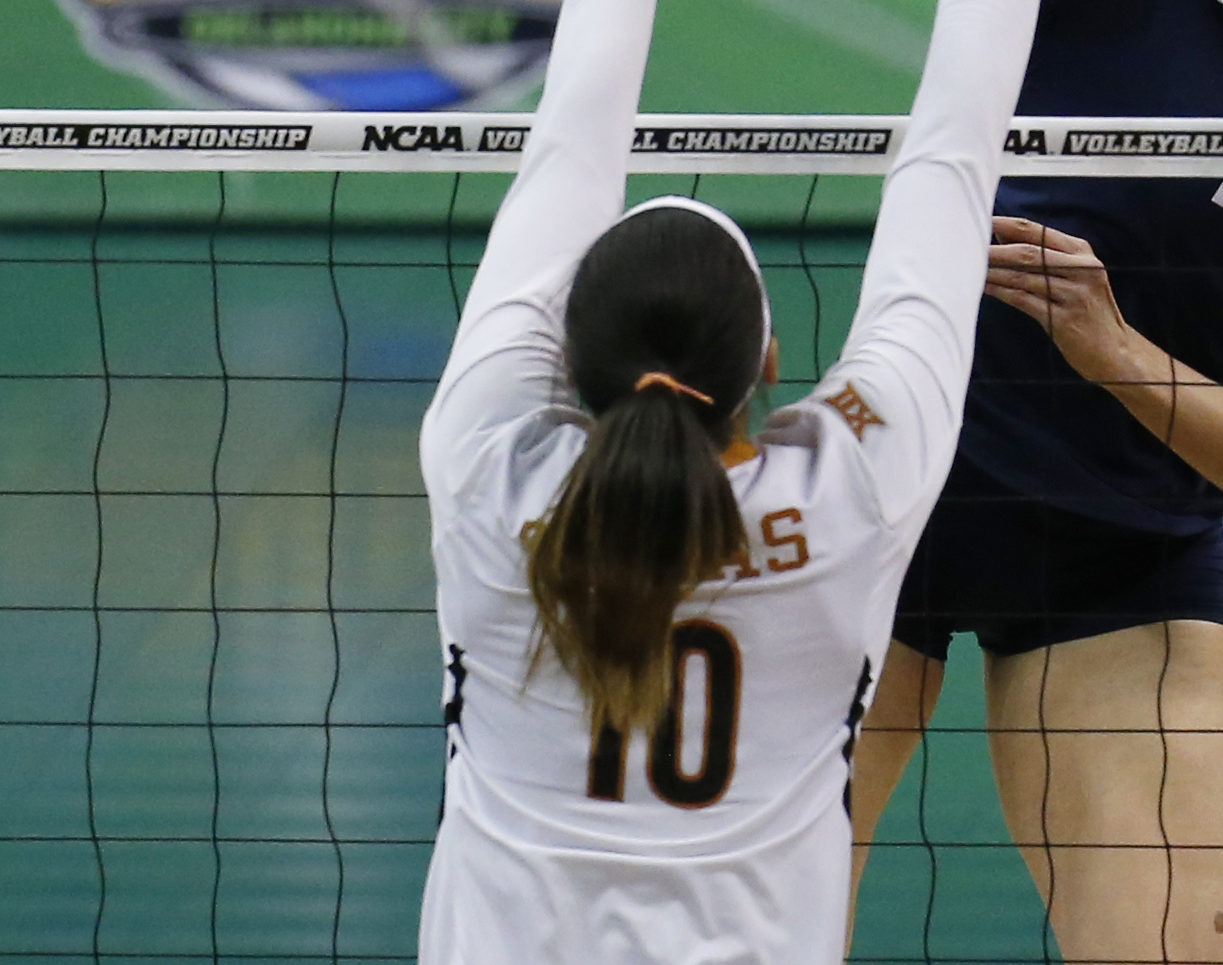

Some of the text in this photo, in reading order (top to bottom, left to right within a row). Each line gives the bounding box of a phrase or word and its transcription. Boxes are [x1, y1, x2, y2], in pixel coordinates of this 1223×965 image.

[87, 127, 306, 148] CHAMPIONSHIP
[362, 125, 464, 152] NCAA
[667, 131, 887, 152] CHAMPIONSHIP
